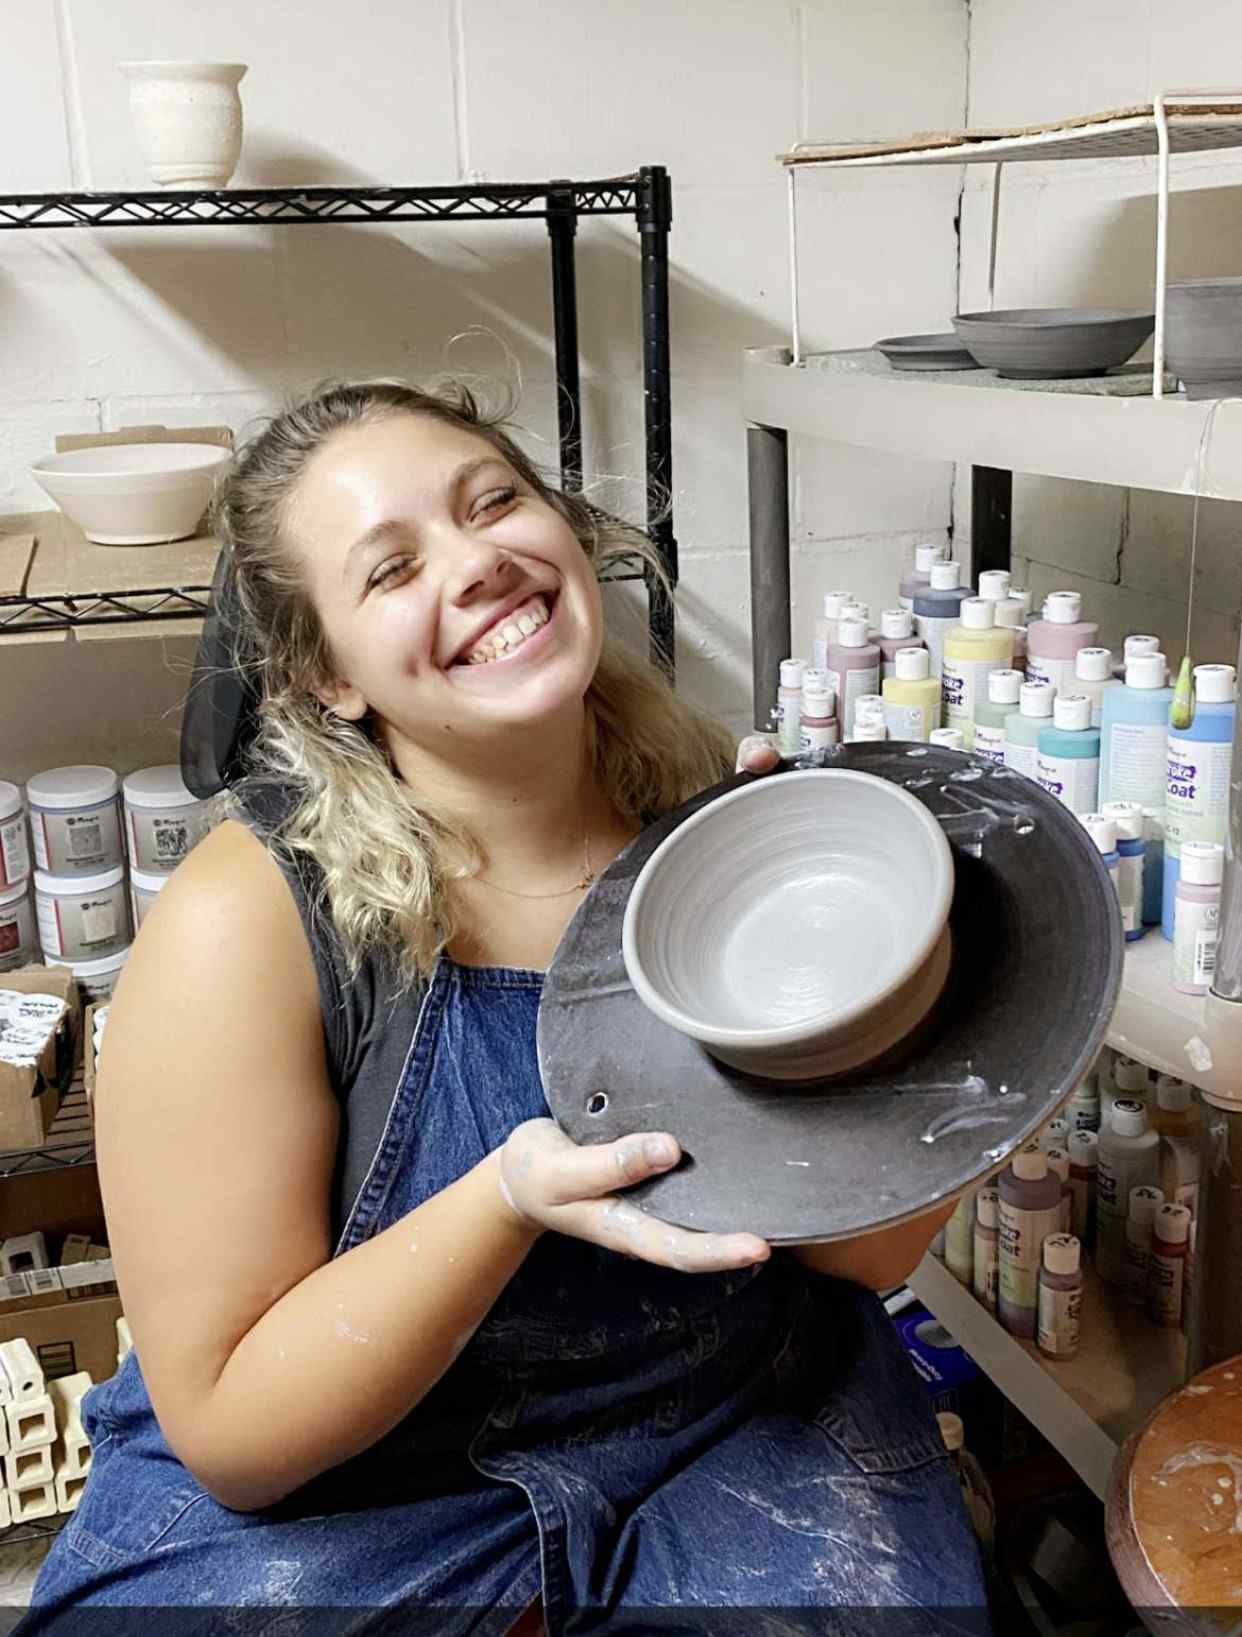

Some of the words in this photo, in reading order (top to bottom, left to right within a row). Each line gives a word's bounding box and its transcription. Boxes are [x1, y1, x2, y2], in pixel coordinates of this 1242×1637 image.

[944, 692, 963, 705] oat
[1167, 784, 1196, 799] oat
[1000, 1239, 1021, 1257] oat
